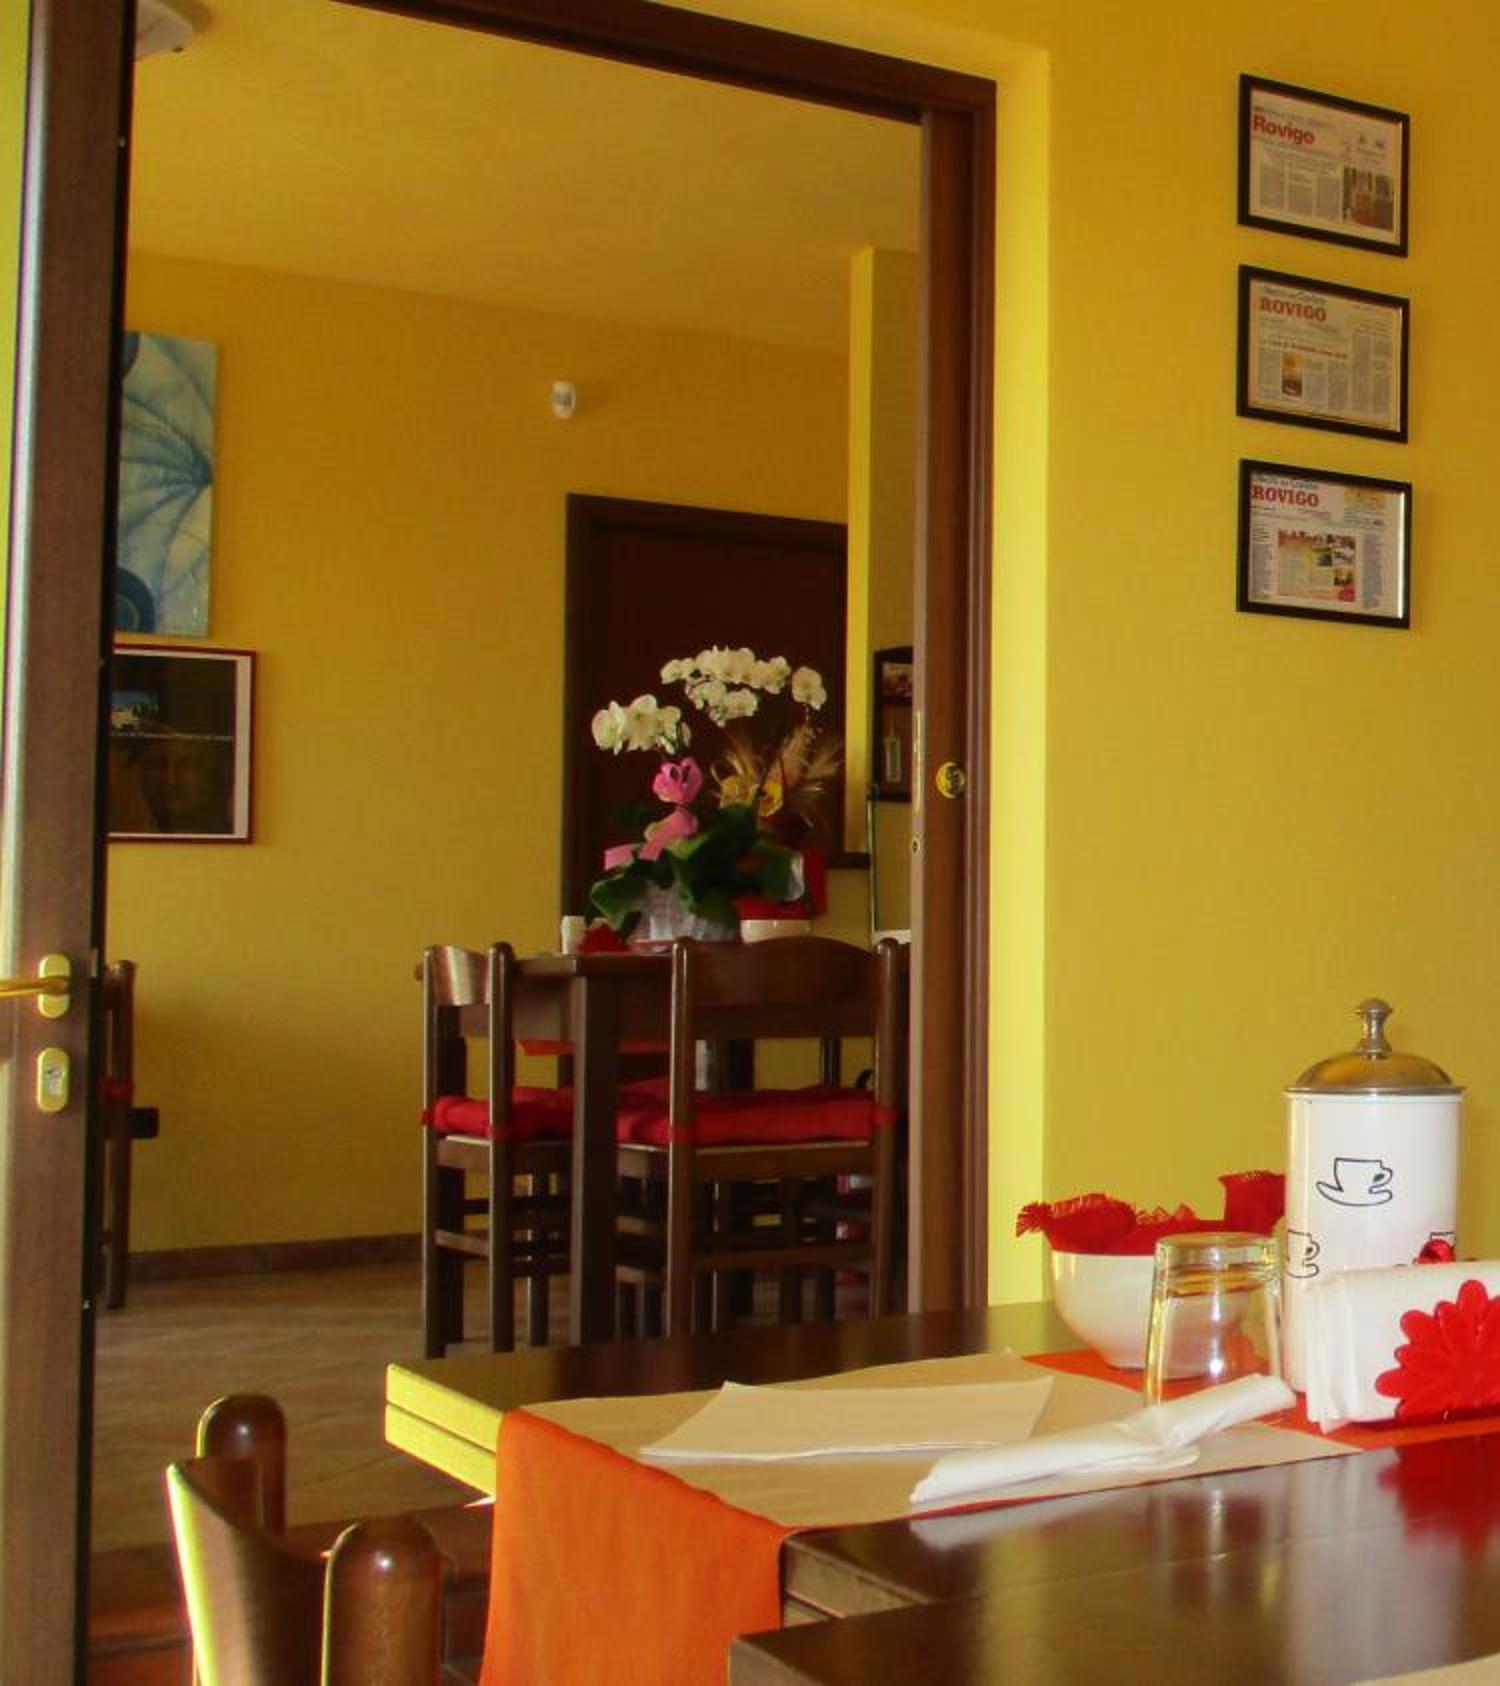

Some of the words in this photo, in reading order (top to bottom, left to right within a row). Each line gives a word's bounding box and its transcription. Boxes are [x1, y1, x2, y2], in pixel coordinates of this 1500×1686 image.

[1252, 114, 1315, 145] Rovigo
[1259, 297, 1327, 322] ROVIGO
[1251, 484, 1320, 508] ROVIGO
